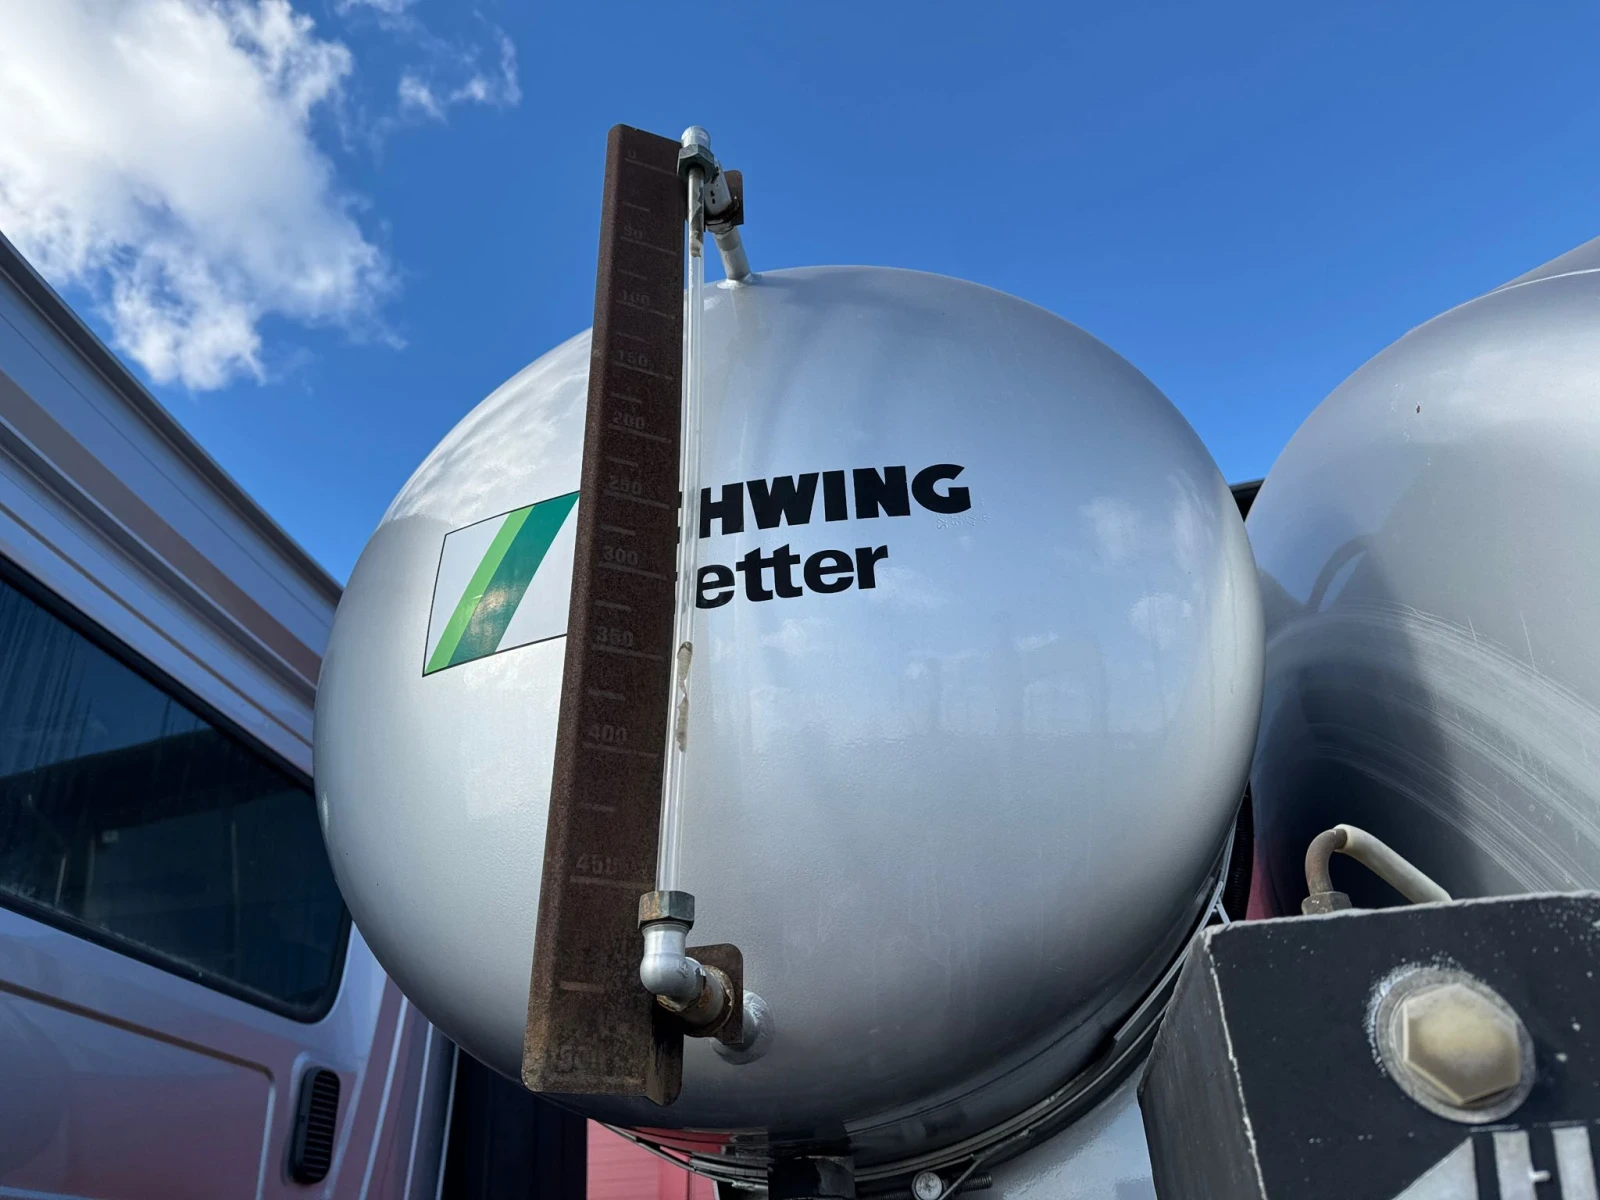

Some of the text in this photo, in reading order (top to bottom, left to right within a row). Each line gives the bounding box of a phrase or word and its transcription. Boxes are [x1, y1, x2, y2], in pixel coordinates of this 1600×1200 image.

[617, 350, 648, 367] 150
[612, 411, 645, 430] 200
[608, 474, 642, 495] 250
[697, 464, 972, 539] HWING
[602, 545, 638, 566] 300
[695, 544, 888, 609] etter
[596, 626, 633, 647] 350
[588, 724, 627, 745] 400
